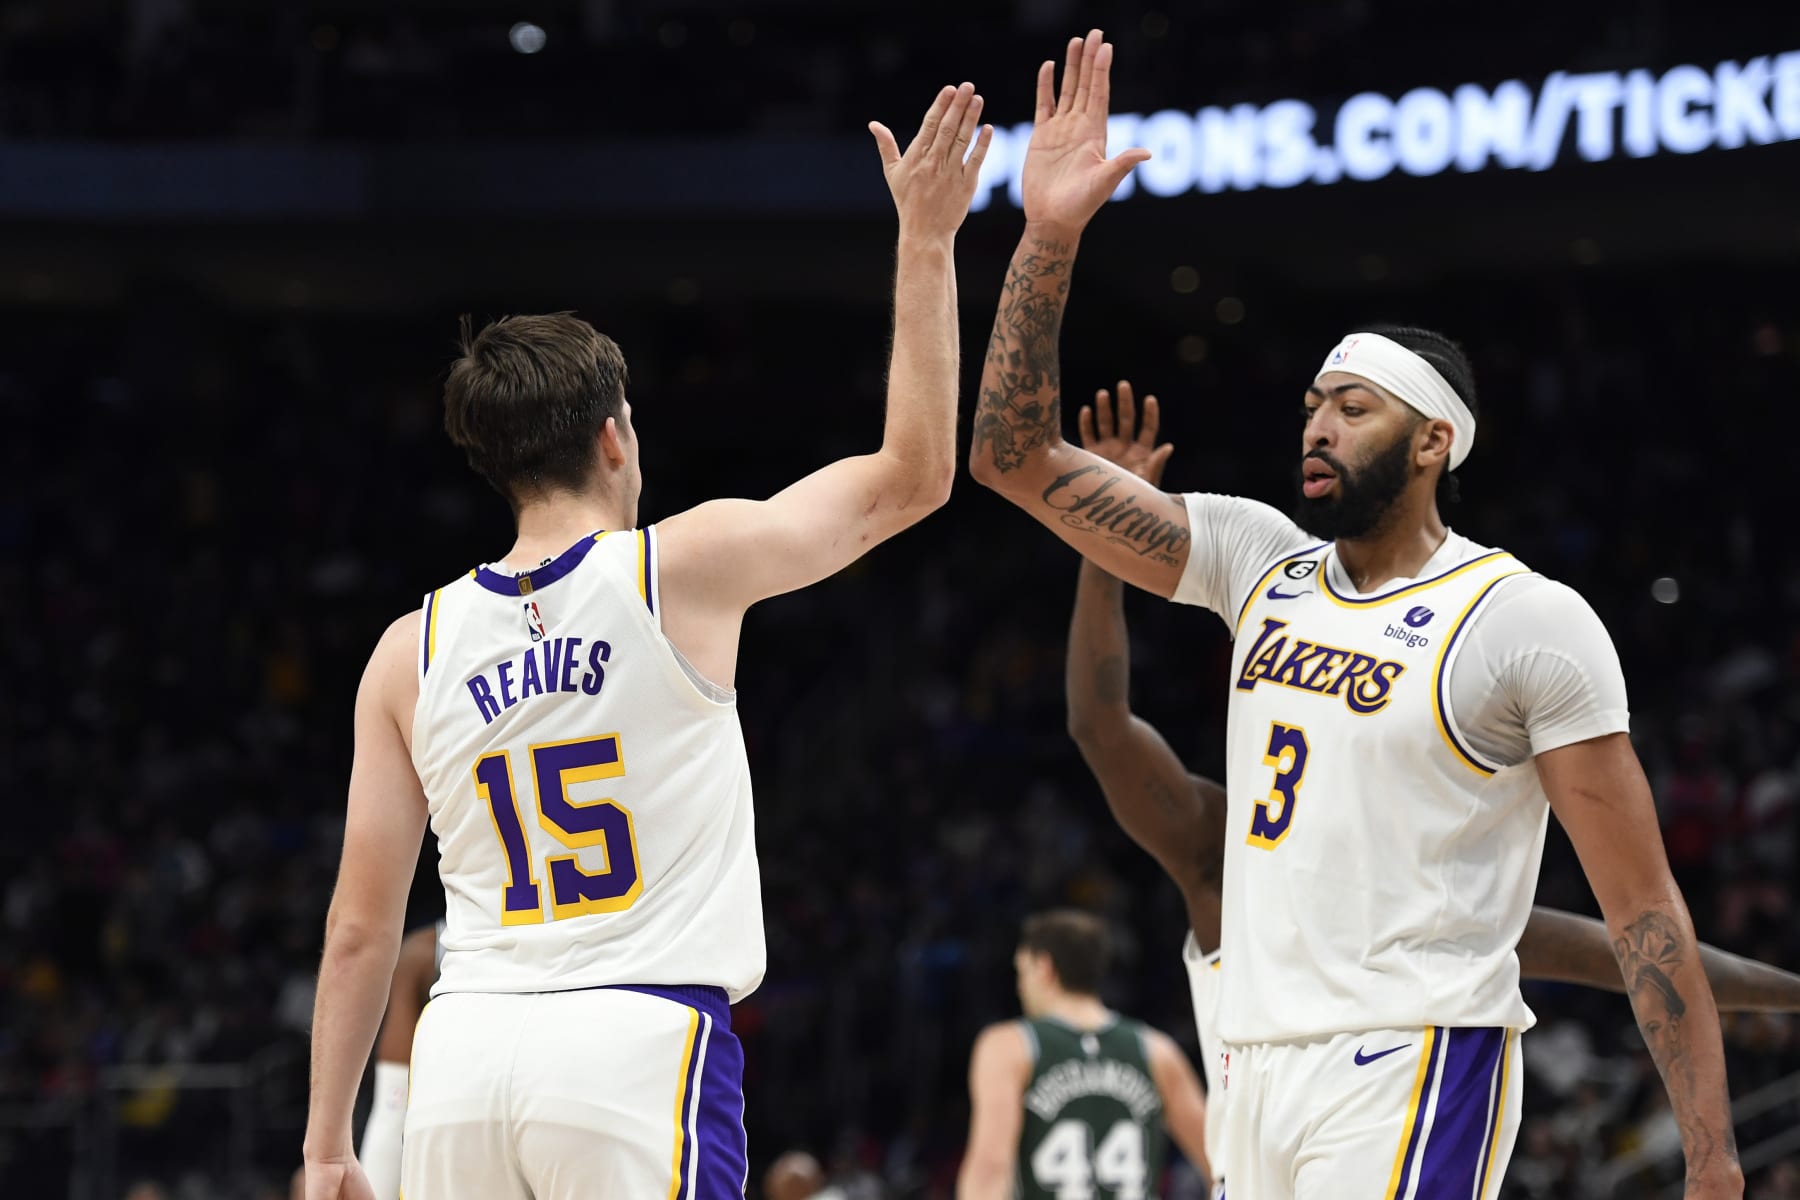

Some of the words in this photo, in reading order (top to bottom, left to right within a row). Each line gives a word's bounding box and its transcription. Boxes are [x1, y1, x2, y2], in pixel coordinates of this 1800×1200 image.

[1041, 464, 1191, 556] Chicago
[466, 637, 611, 725] REAVES
[1235, 616, 1408, 717] LAKERS
[1384, 624, 1429, 648] bibigo
[472, 732, 644, 927] 15
[1245, 720, 1311, 851] 3
[1031, 1118, 1148, 1200] 44
